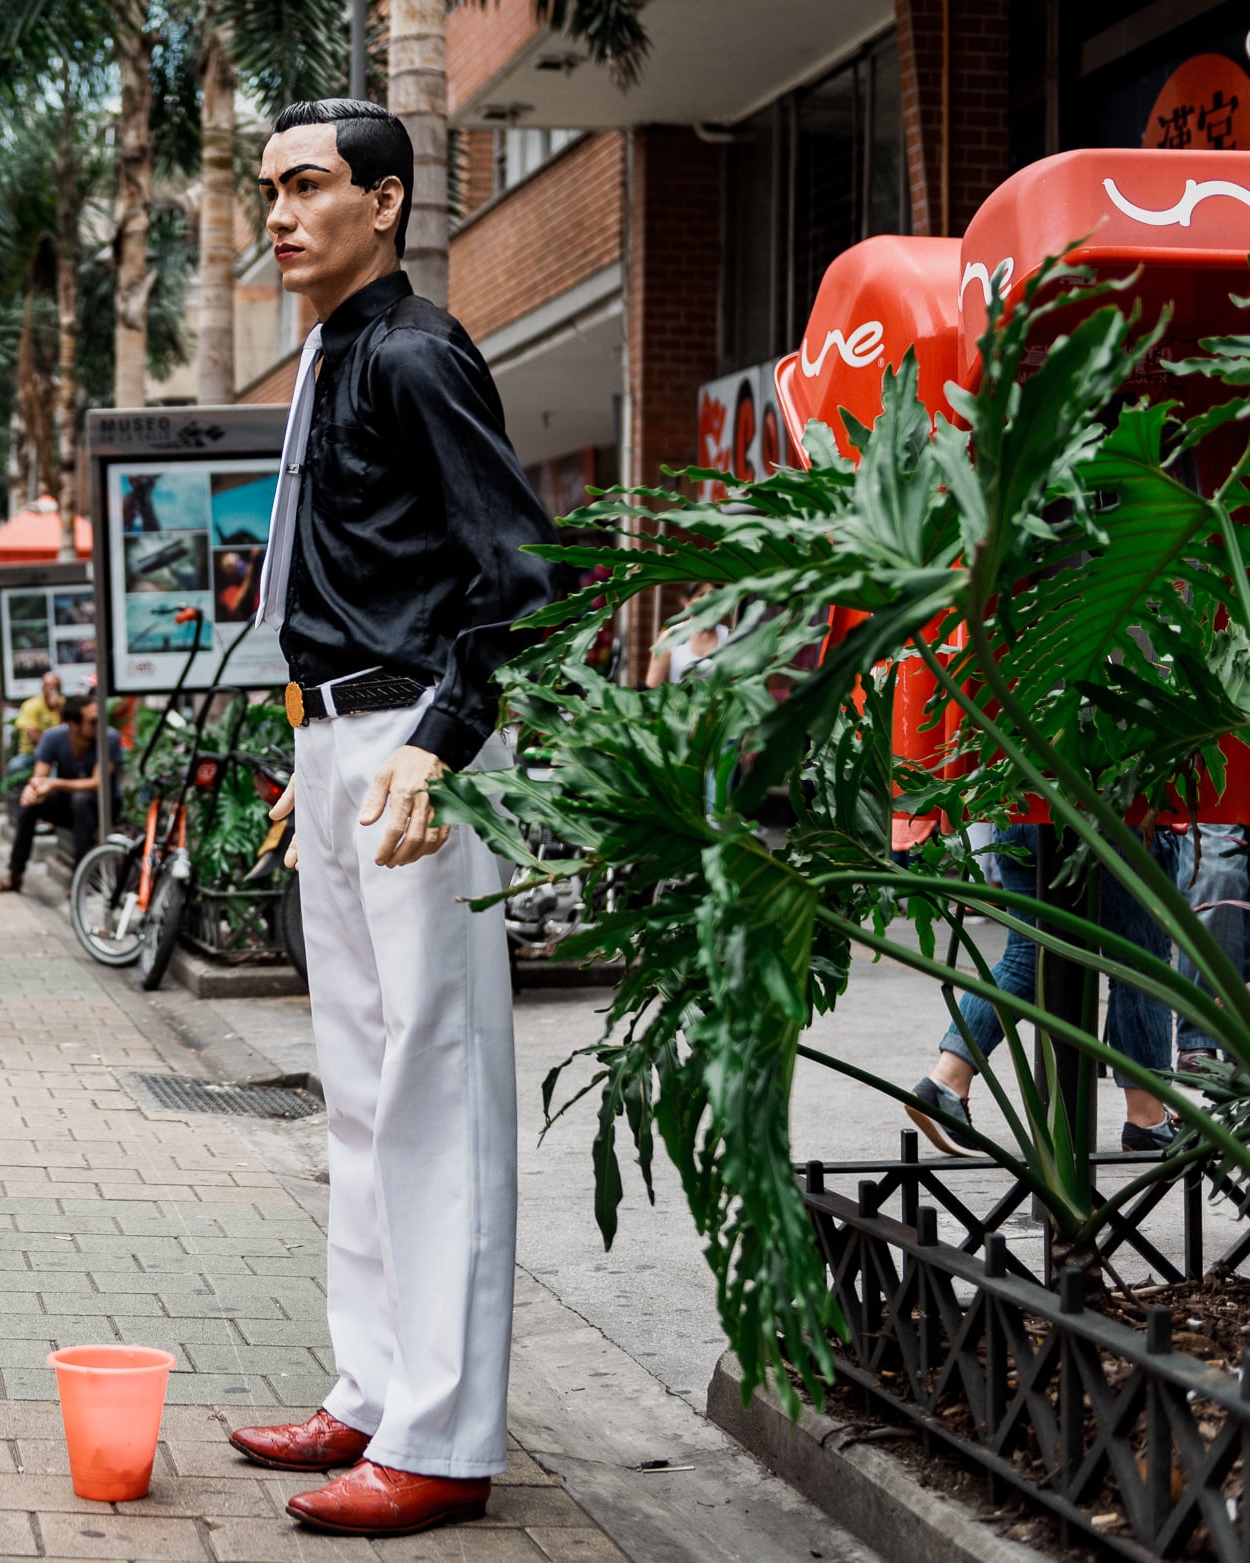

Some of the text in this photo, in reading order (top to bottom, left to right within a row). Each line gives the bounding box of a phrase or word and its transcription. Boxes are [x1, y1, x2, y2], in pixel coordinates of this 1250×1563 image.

[957, 256, 1015, 313] ne
[801, 320, 885, 378] une
[100, 416, 171, 432] MUSEO
